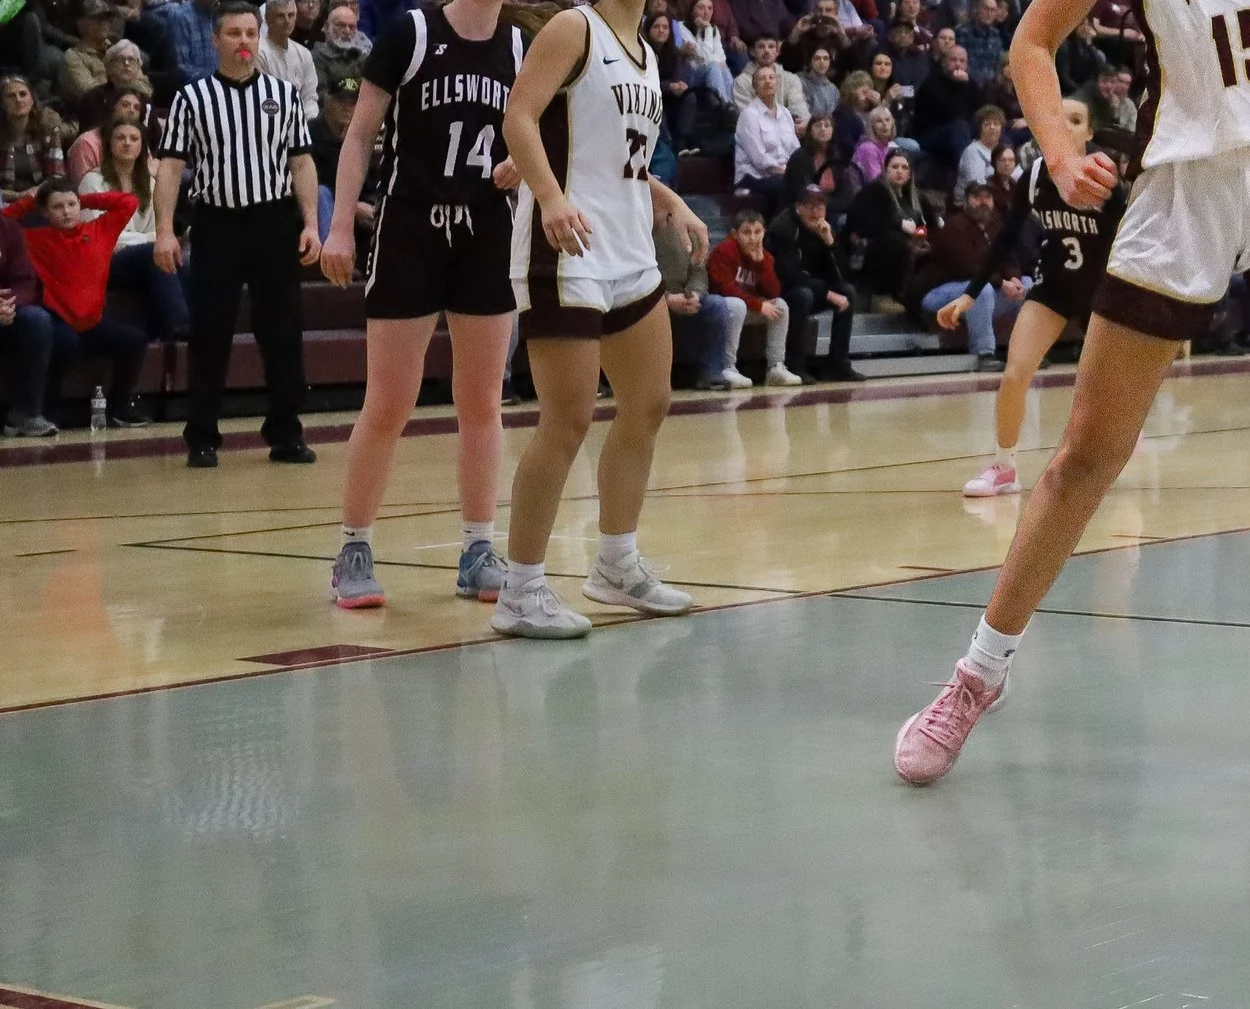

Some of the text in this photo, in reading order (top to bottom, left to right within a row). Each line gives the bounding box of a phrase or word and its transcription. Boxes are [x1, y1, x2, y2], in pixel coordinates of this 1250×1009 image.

[421, 73, 510, 114] ELLSWORT
[443, 120, 496, 179] 14
[1041, 210, 1099, 235] LSWORTH
[1061, 237, 1084, 270] 3
